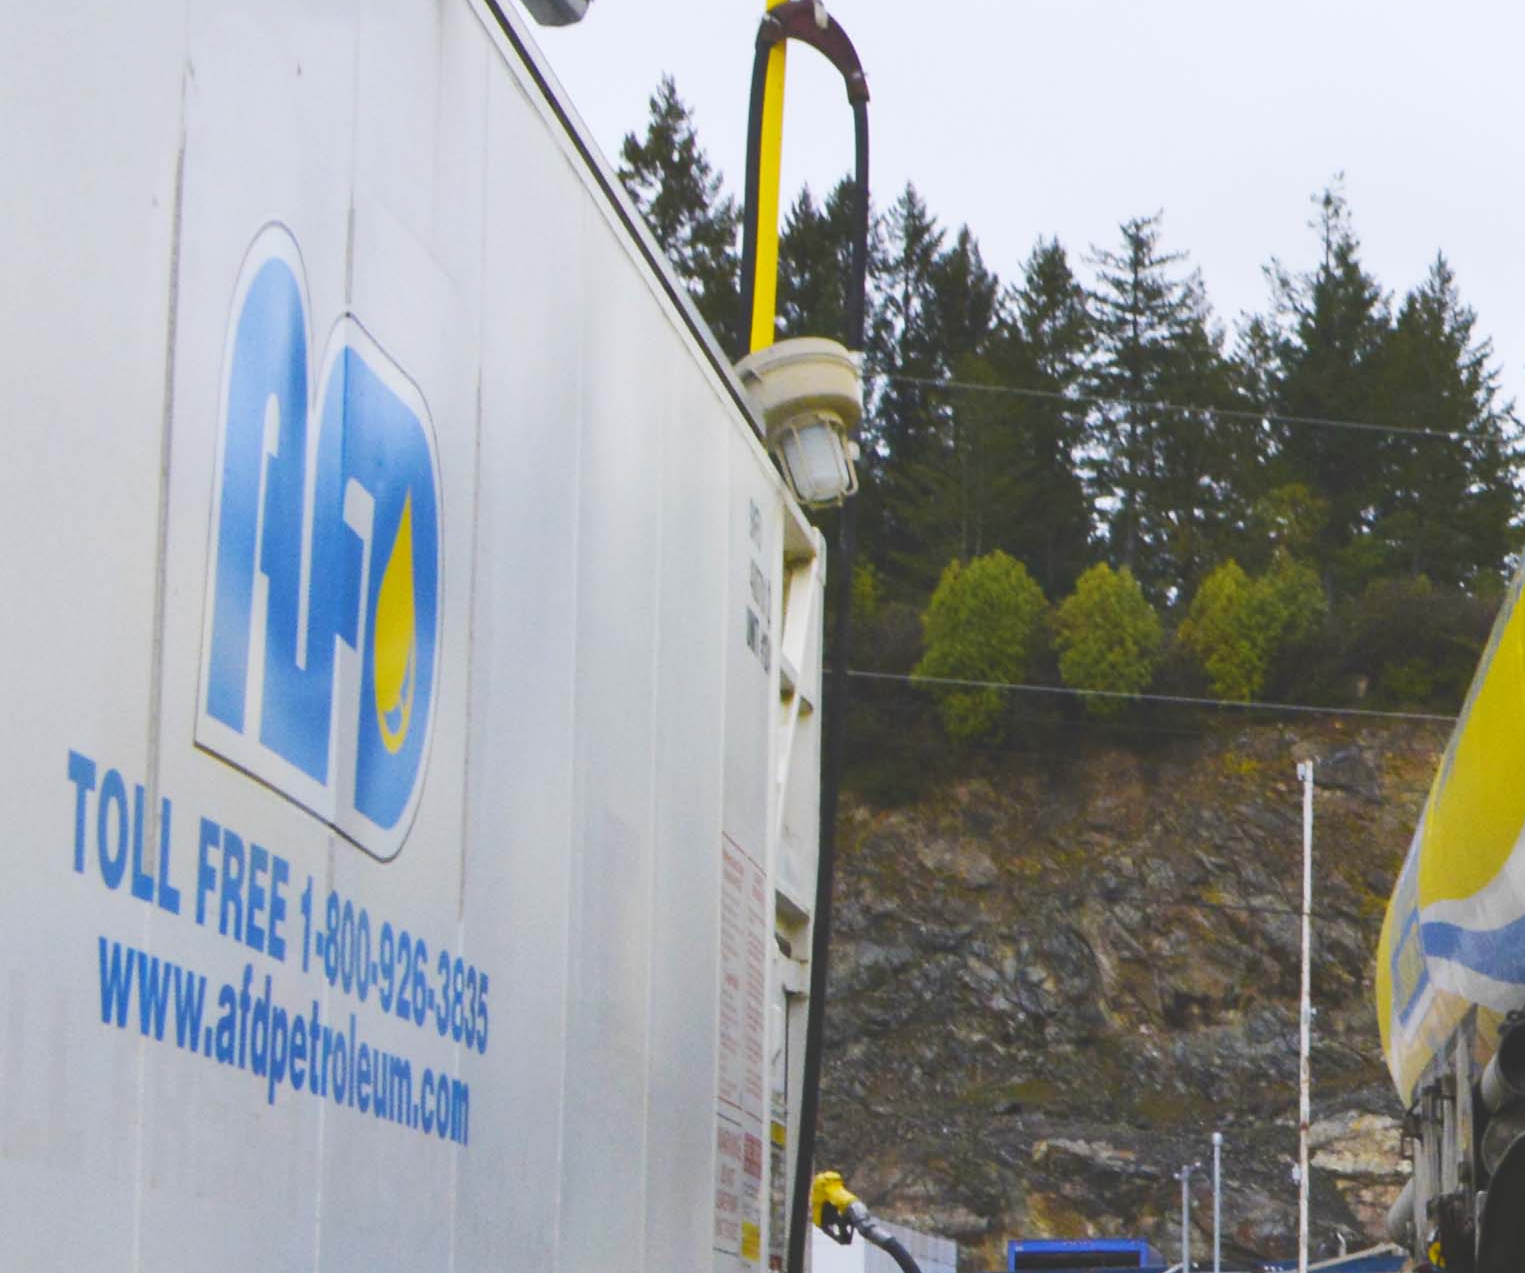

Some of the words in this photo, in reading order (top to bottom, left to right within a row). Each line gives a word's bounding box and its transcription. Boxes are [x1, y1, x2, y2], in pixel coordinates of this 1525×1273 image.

[67, 747, 181, 917] TOLL
[194, 815, 290, 965] FREE
[300, 873, 489, 1056] 1-800-926-3835
[98, 934, 470, 1148] www.afdpetroleum.com
